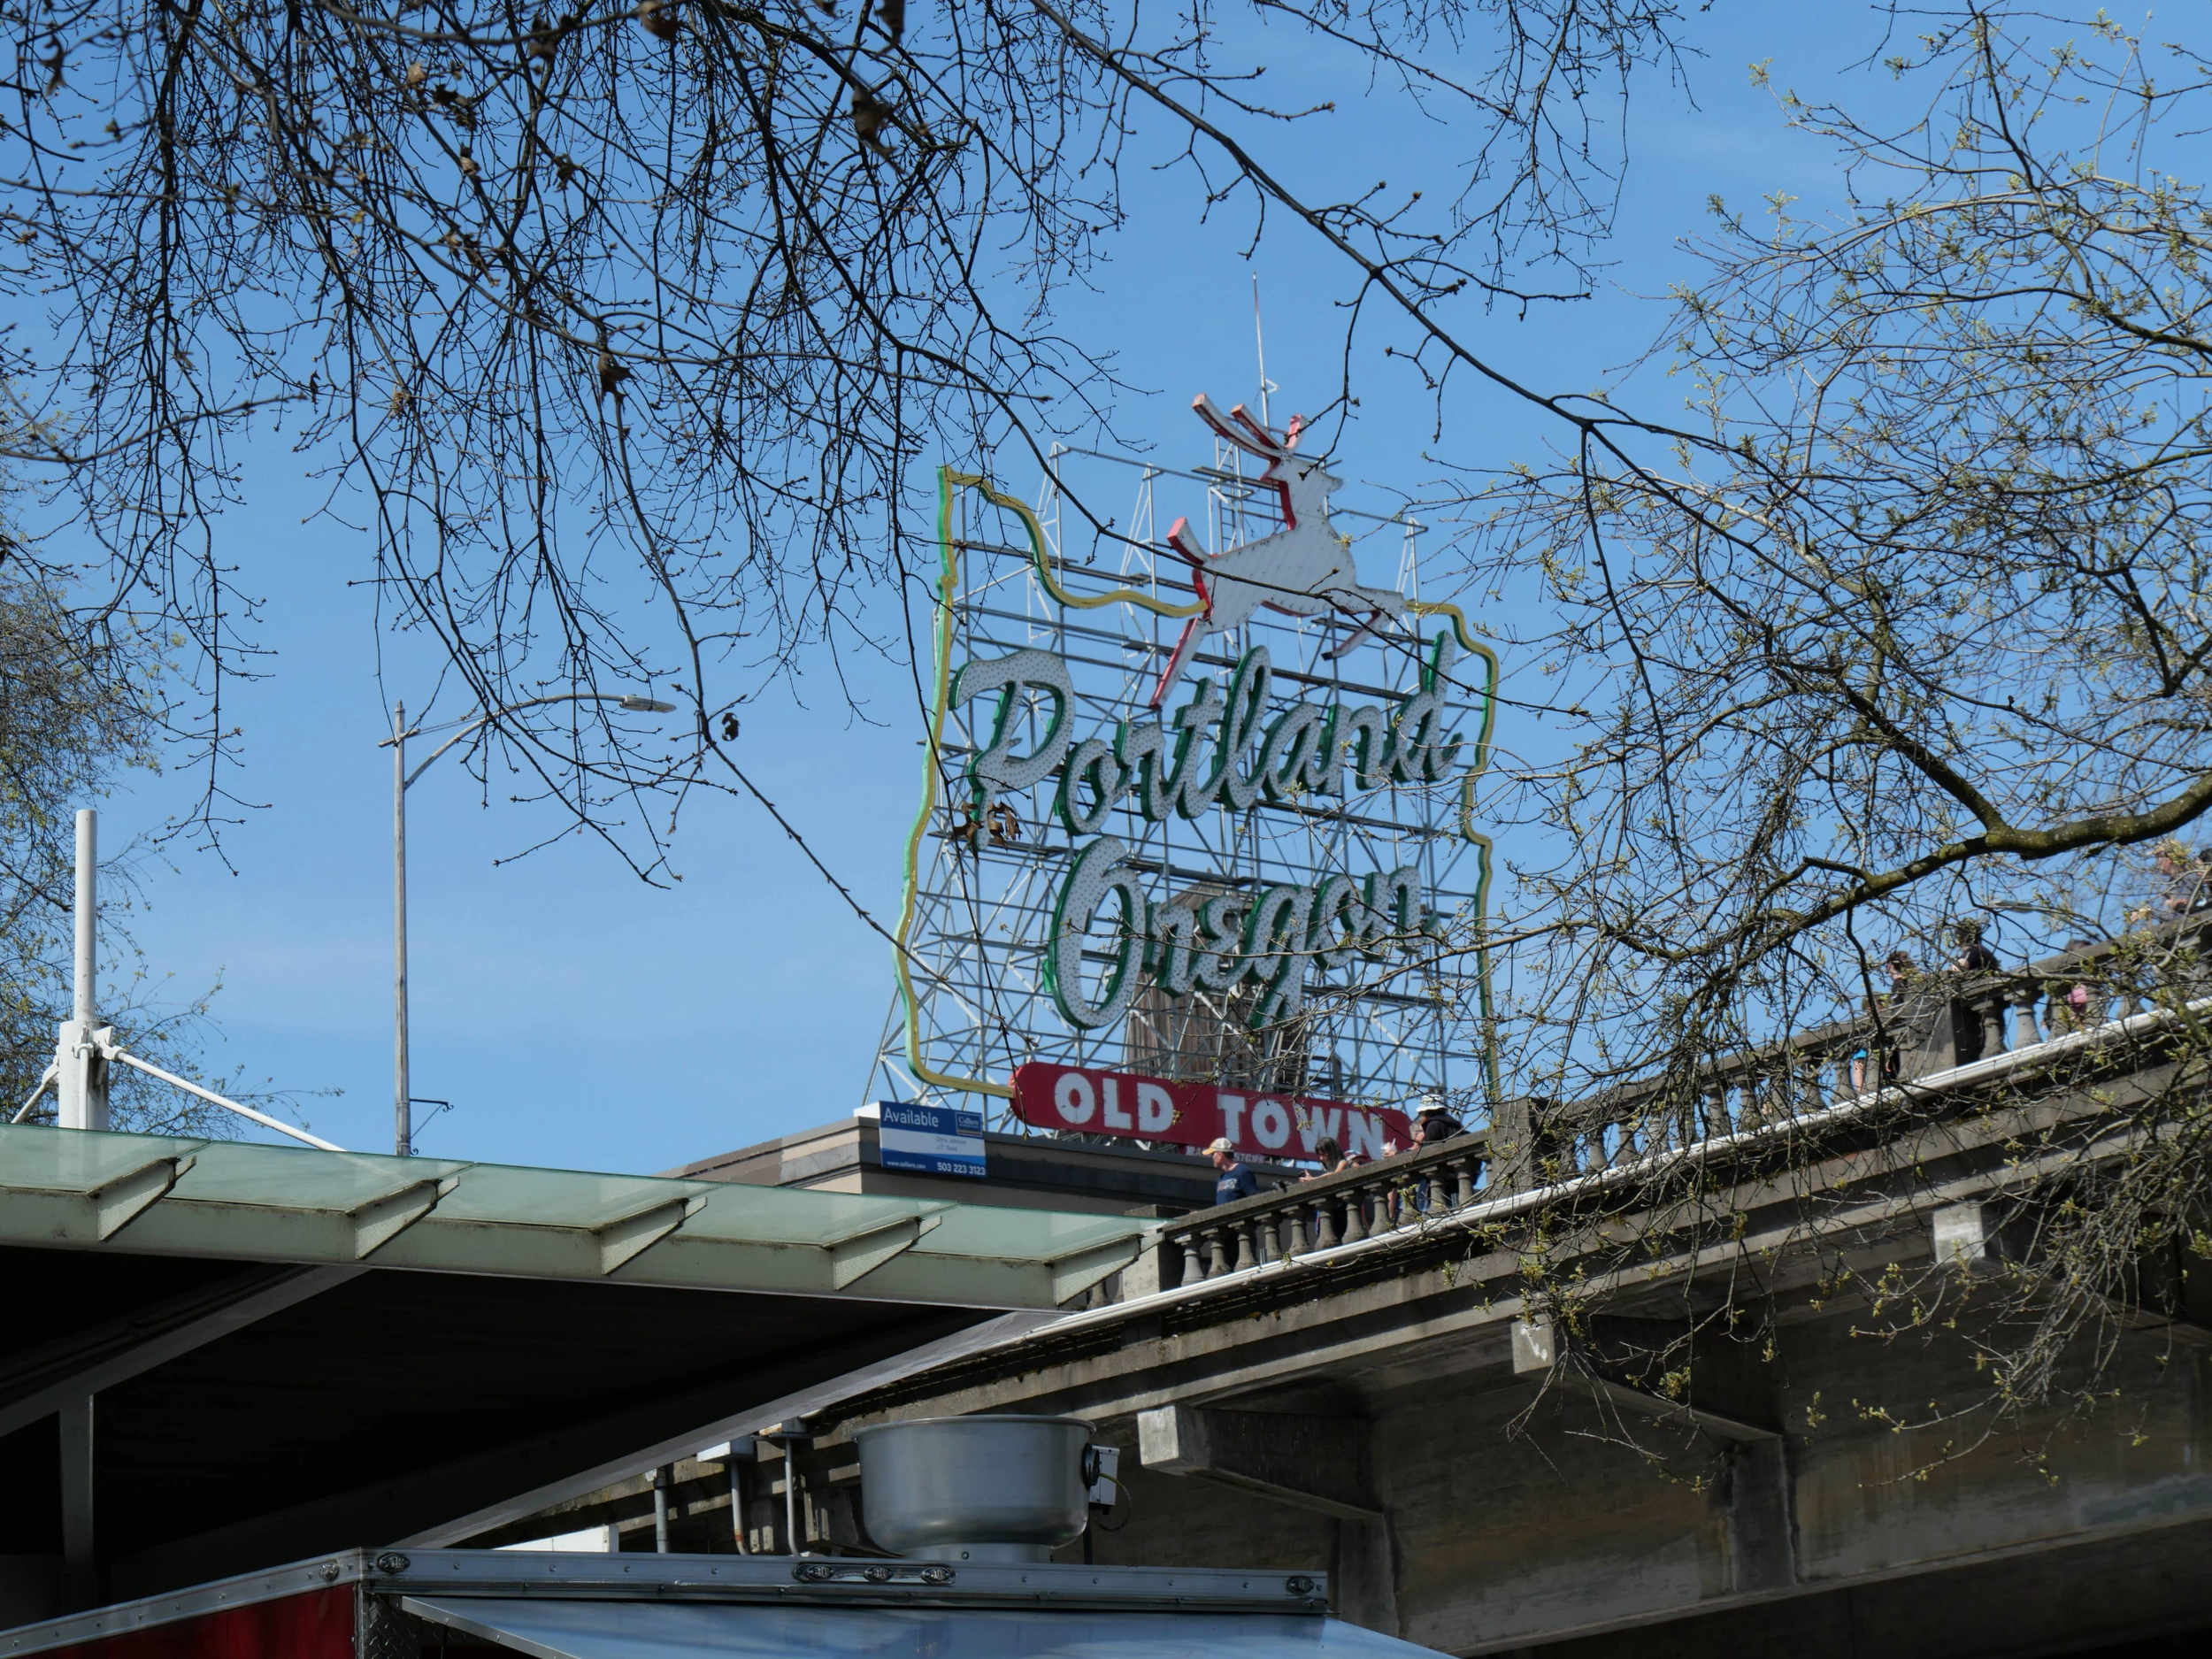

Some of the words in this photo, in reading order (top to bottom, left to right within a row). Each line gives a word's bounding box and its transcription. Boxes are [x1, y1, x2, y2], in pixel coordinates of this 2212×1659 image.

[948, 629, 1464, 850] Portland
[1044, 835, 1439, 1030] Oregon
[884, 1107, 939, 1126] Available
[1054, 1072, 1174, 1133] OLD
[1217, 1094, 1385, 1162] TOWN
[937, 1162, 951, 1171] 503
[953, 1164, 967, 1173] 223
[969, 1165, 986, 1175] 3123
